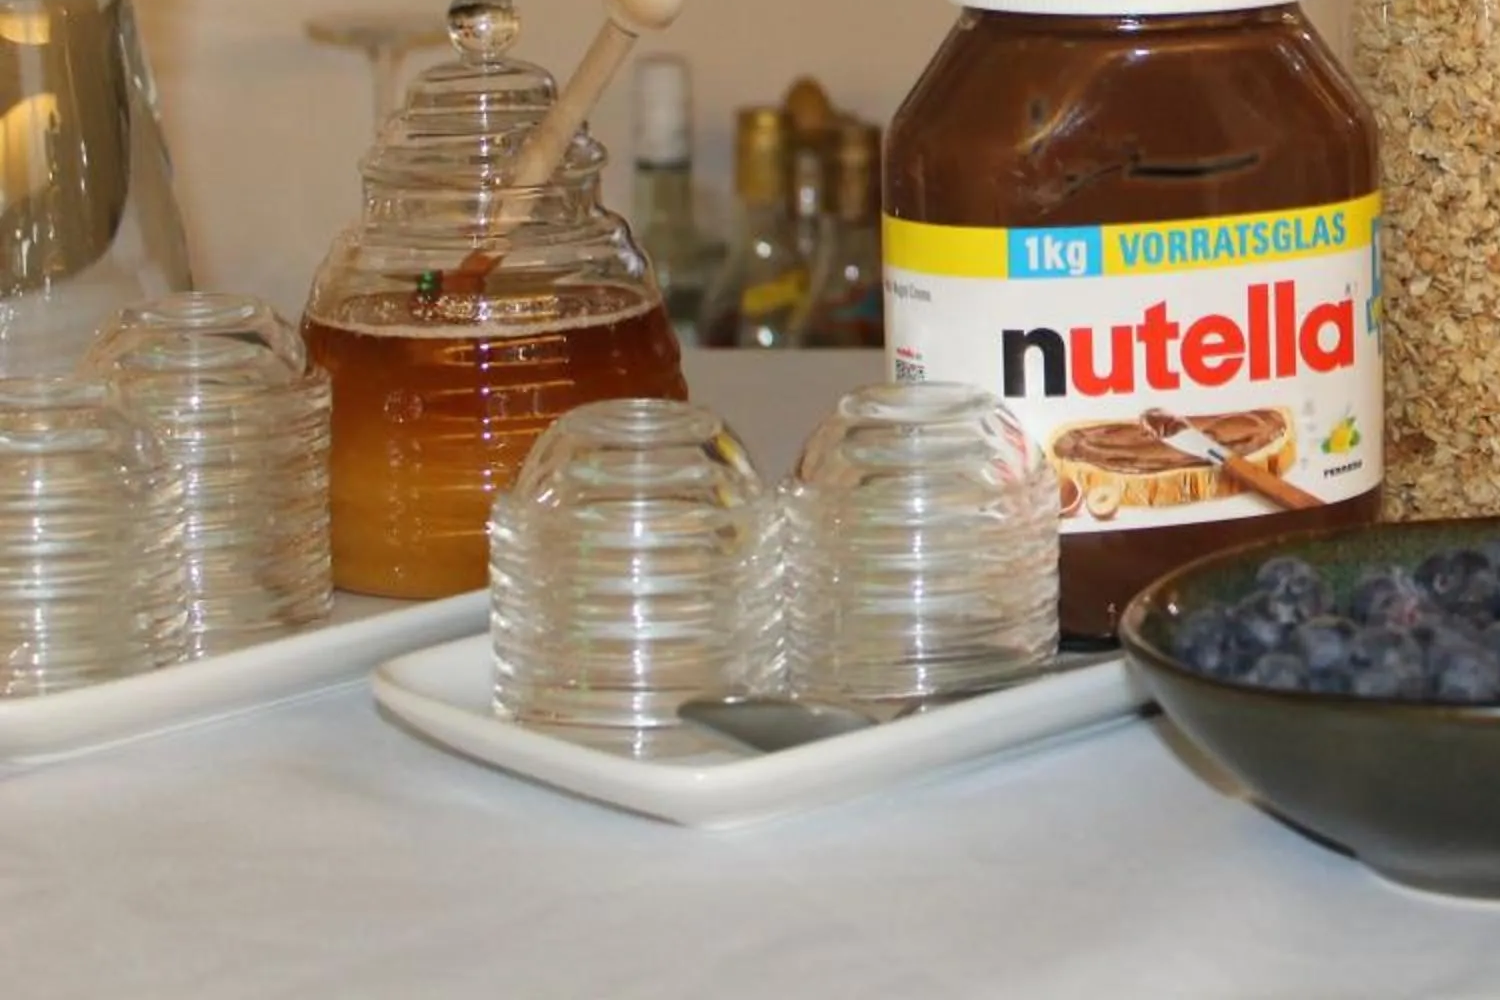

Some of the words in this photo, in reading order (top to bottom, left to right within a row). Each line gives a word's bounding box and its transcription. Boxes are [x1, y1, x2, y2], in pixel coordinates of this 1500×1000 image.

[1024, 234, 1088, 275] 1kg
[1119, 212, 1347, 265] VORRATSGLAS
[1001, 279, 1355, 399] nutella
